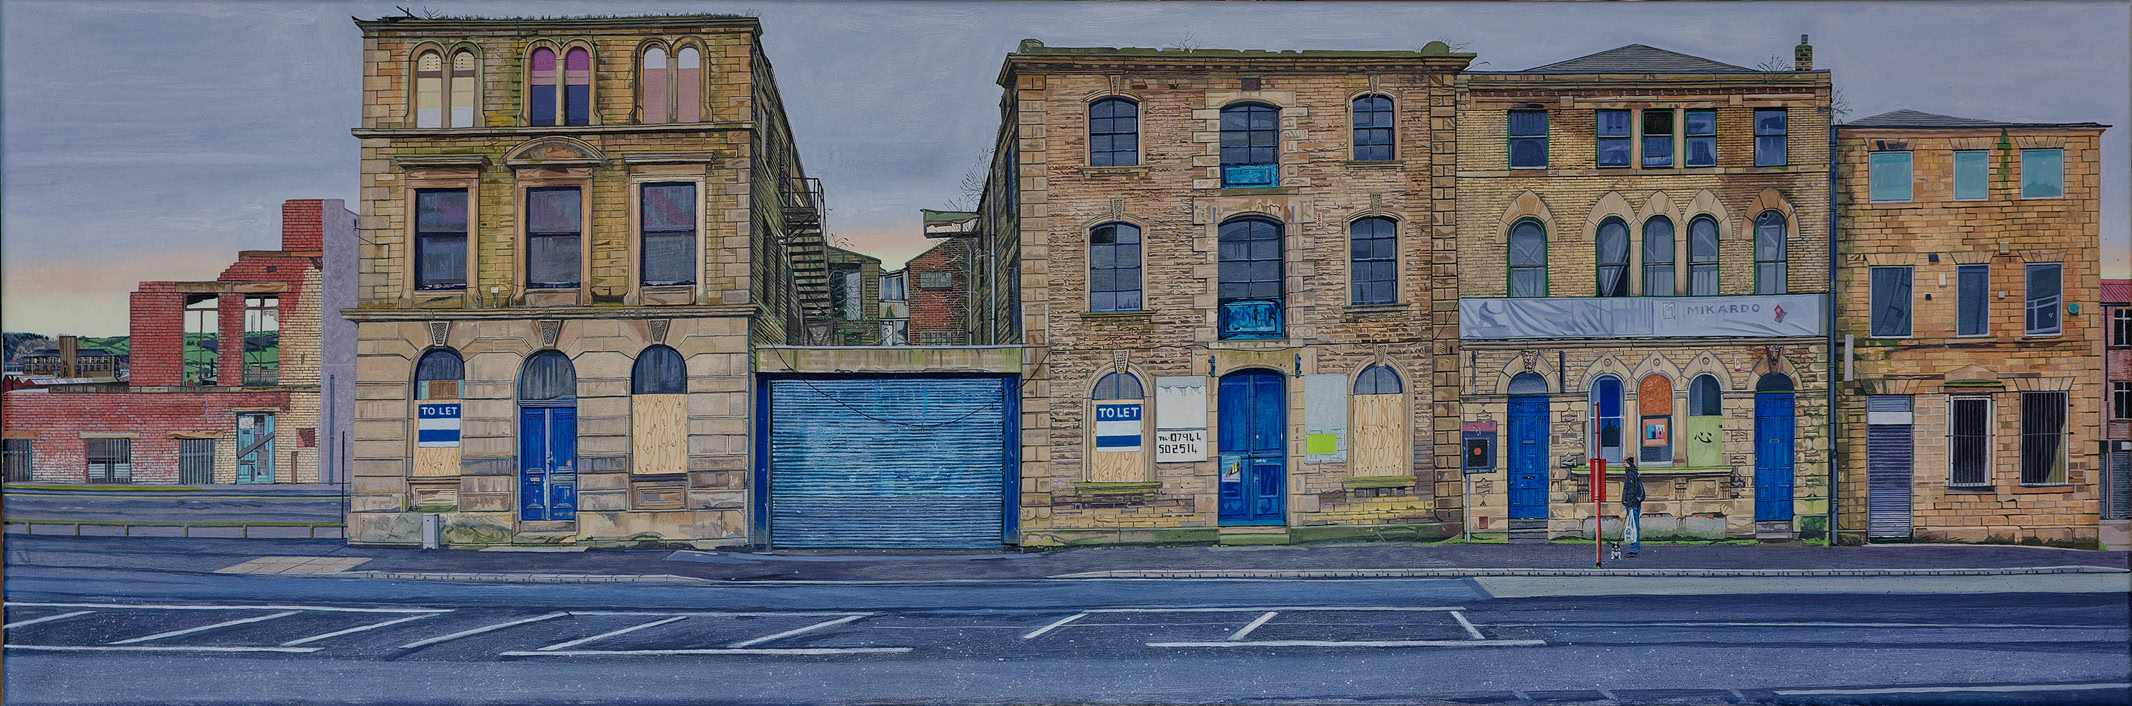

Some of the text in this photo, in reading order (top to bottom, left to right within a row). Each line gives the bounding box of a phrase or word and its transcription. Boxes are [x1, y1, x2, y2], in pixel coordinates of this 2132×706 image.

[1687, 304, 1761, 315] MIKARDO
[421, 406, 458, 416] TO LET
[1098, 407, 1140, 418] TO LET
